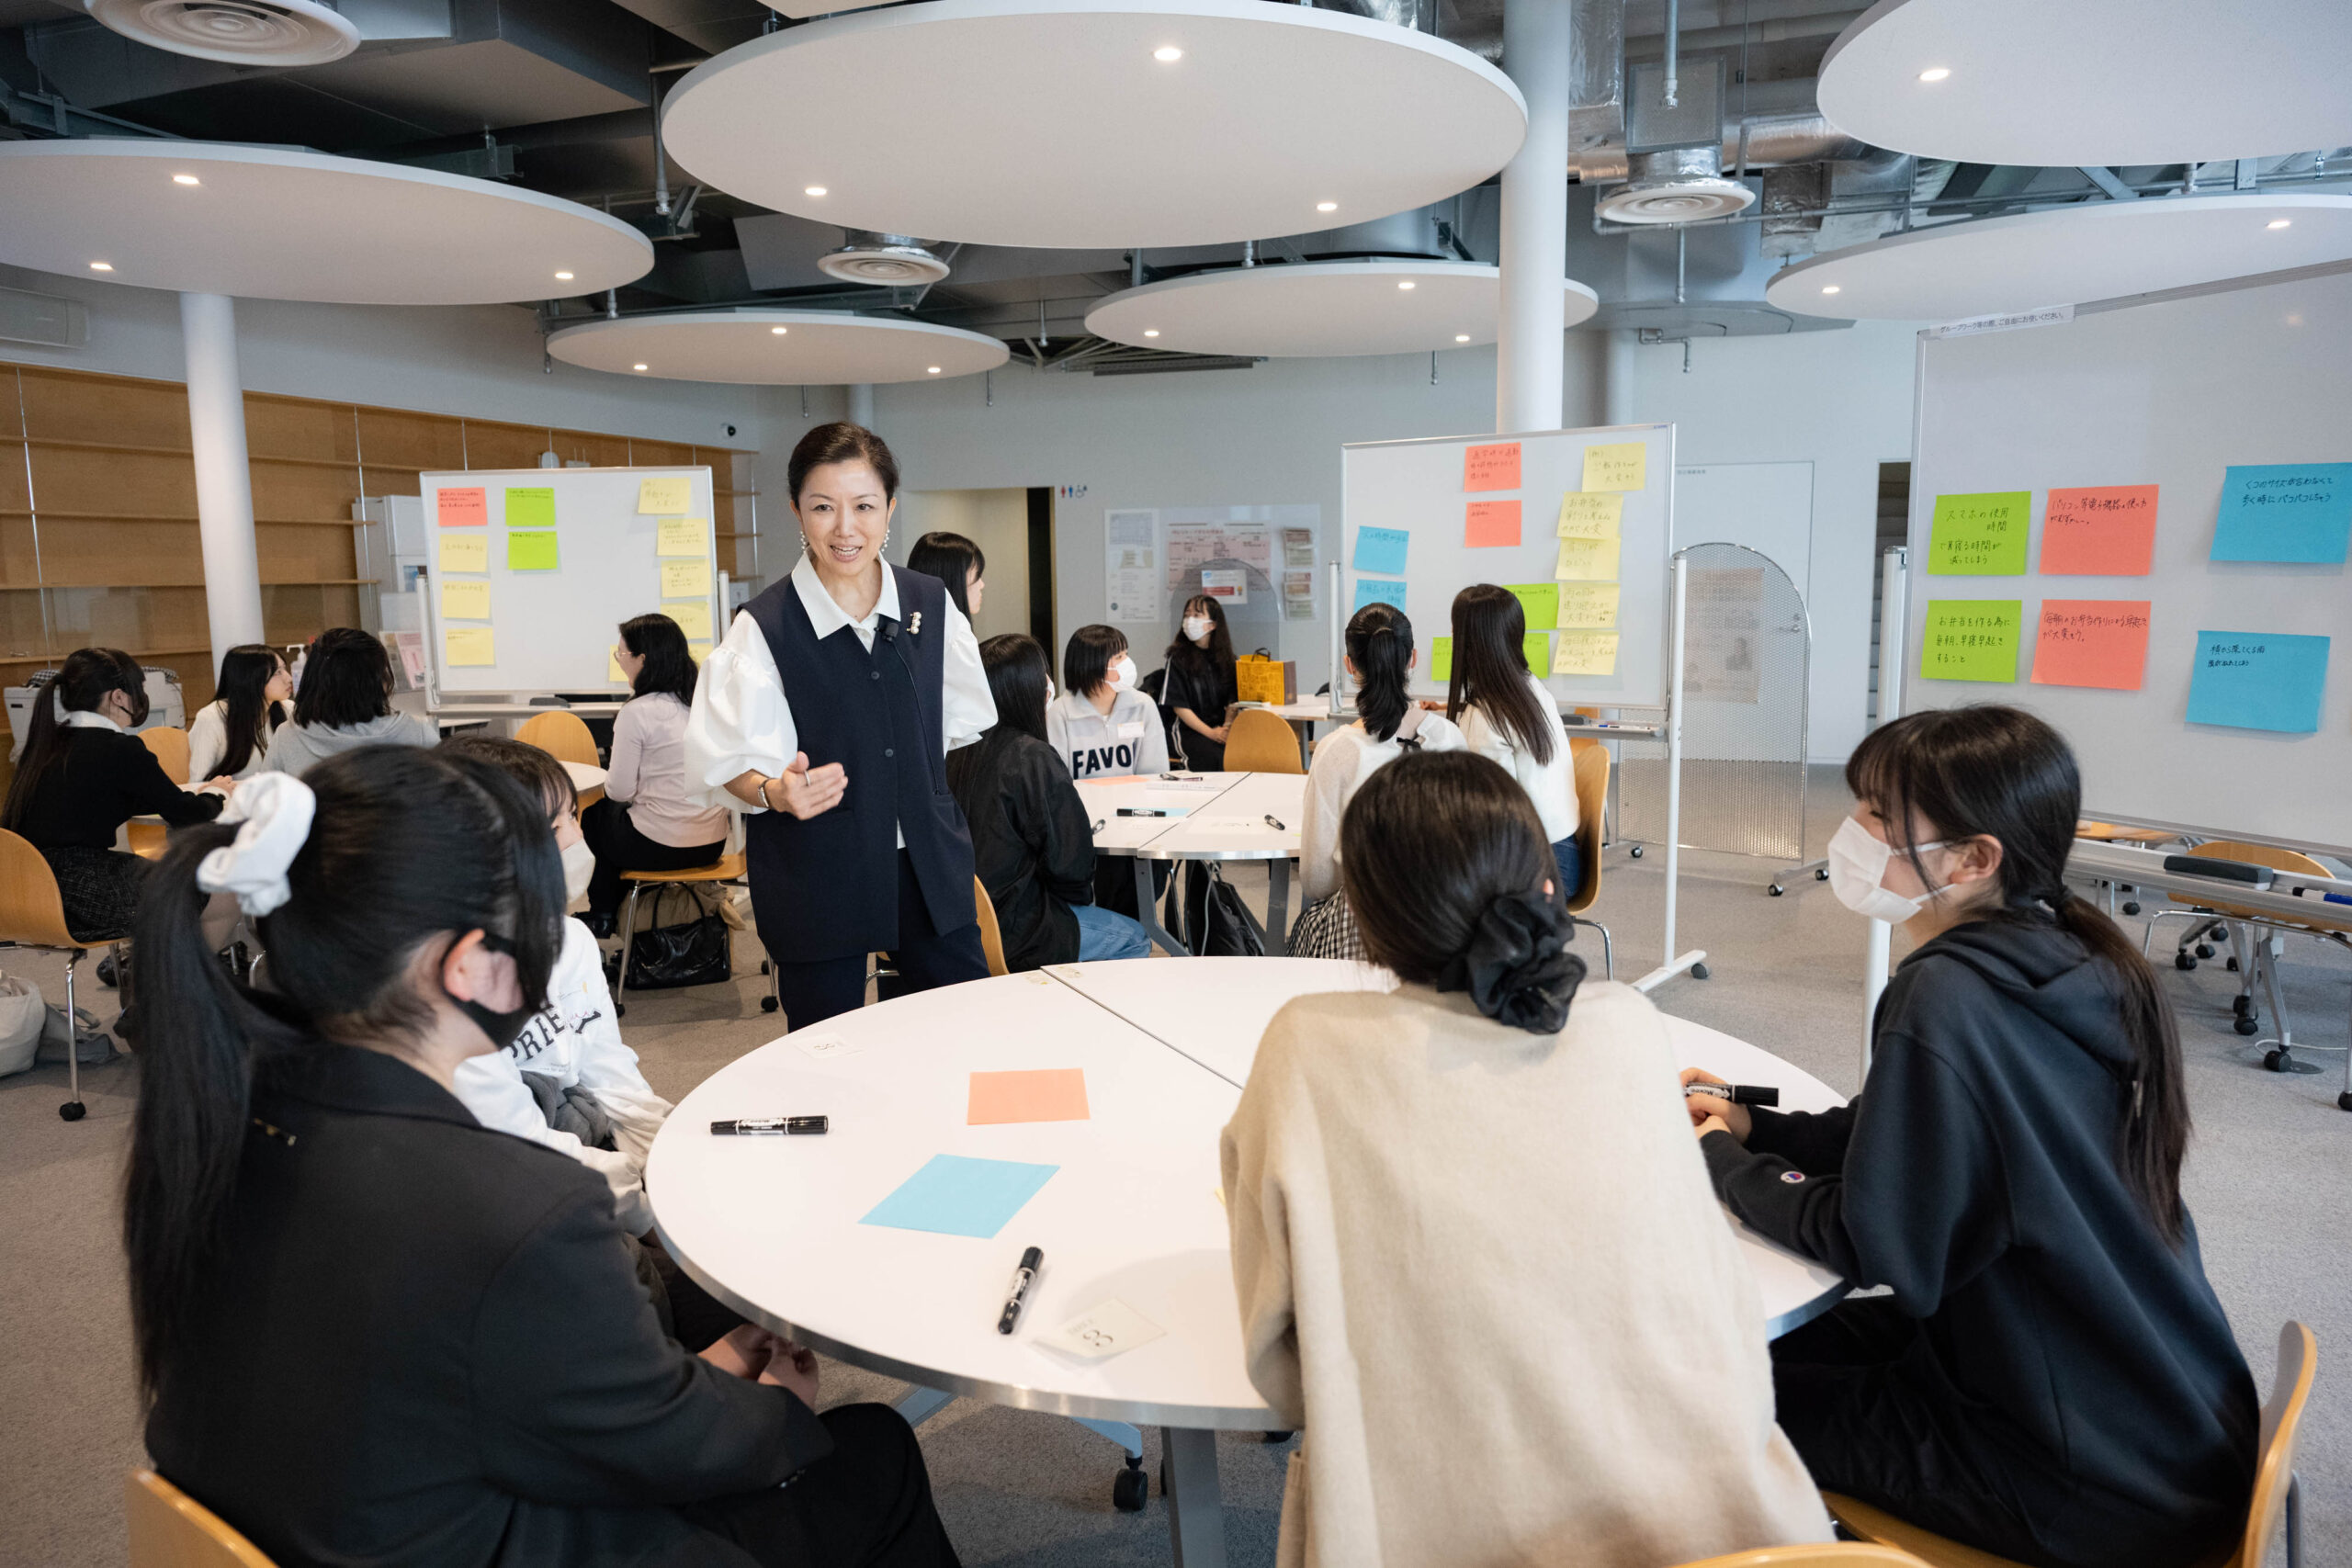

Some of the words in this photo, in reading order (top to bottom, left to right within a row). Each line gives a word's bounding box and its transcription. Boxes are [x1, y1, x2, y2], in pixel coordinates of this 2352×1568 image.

[2245, 477, 2334, 490] くつのサイズが合わなくて
[1946, 507, 2009, 522] スマホの使用
[1985, 520, 2007, 532] 時間
[1939, 616, 2010, 628] お弁当を作る為に
[1936, 634, 2004, 648] 毎朝、早寝早起き
[1937, 653, 1966, 663] すること
[1072, 742, 1136, 780] FAVO
